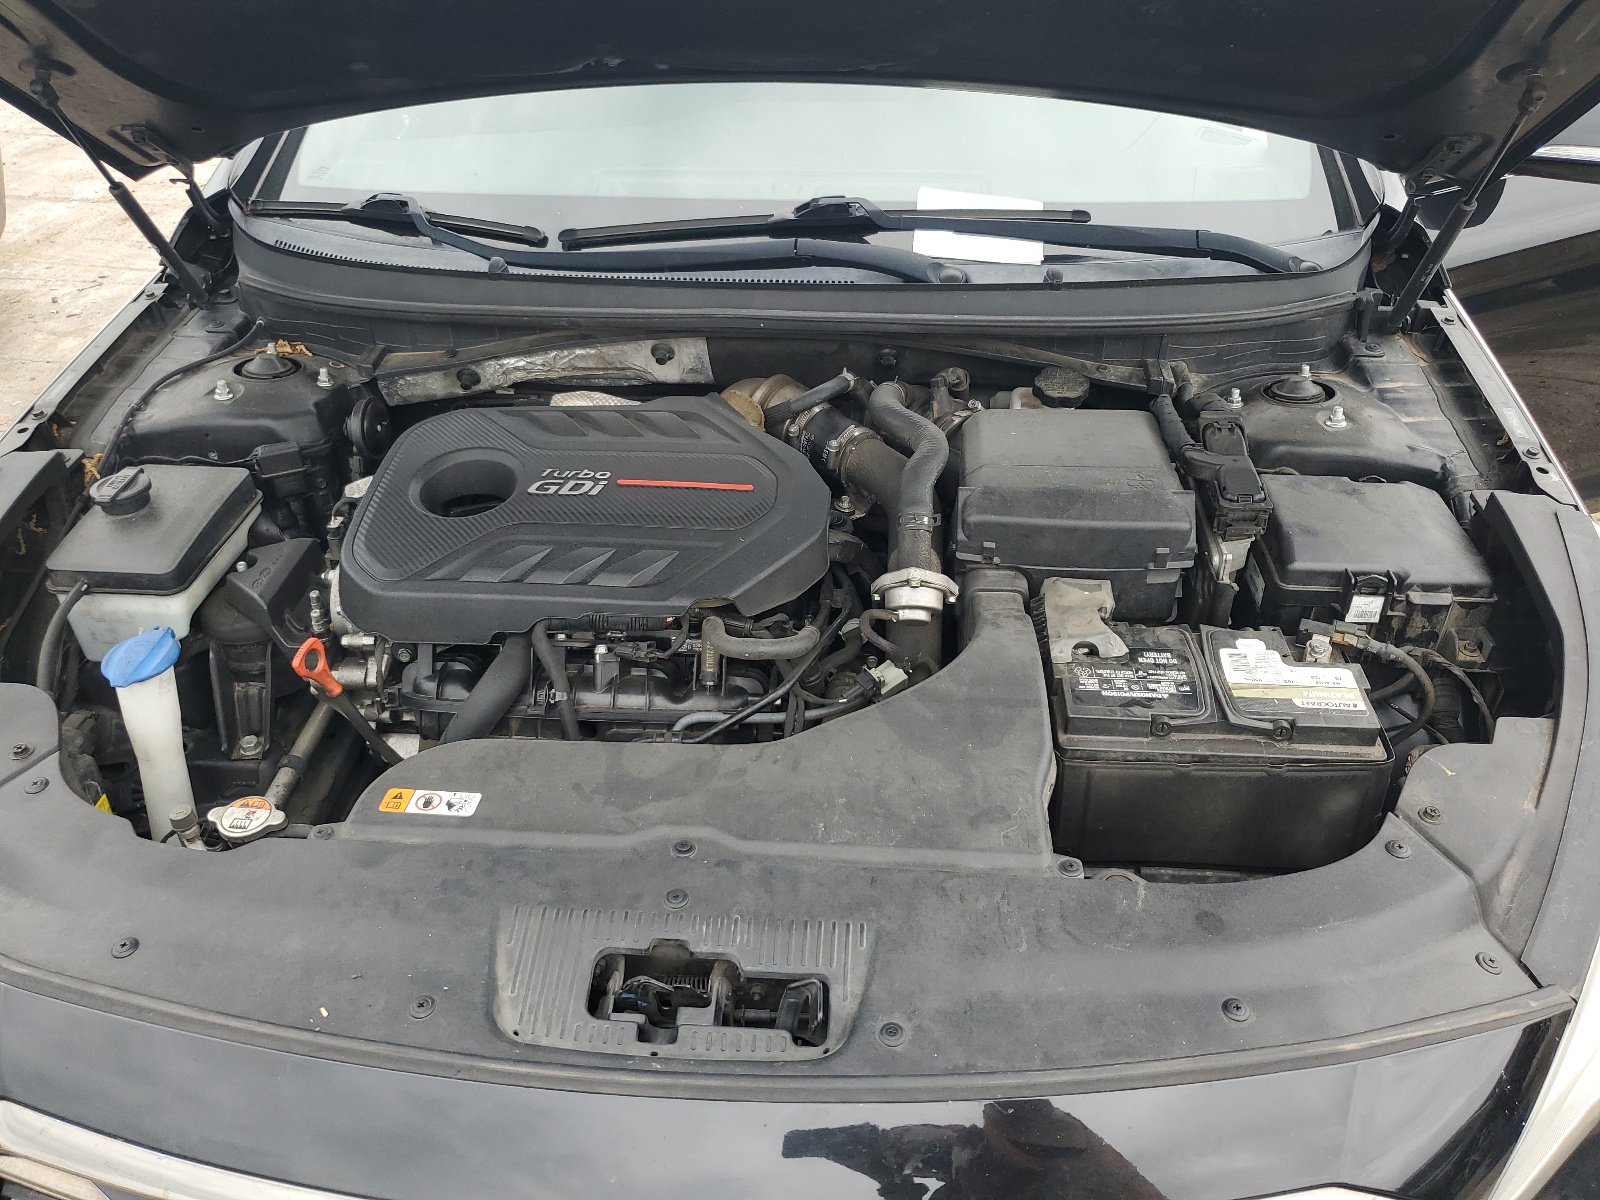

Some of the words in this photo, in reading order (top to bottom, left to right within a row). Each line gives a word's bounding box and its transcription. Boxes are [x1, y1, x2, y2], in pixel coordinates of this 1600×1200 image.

[541, 468, 612, 479] Turbo
[527, 480, 609, 496] GDi
[1302, 690, 1356, 699] PLATINUM
[1300, 700, 1352, 708] AUTOCRAFT
